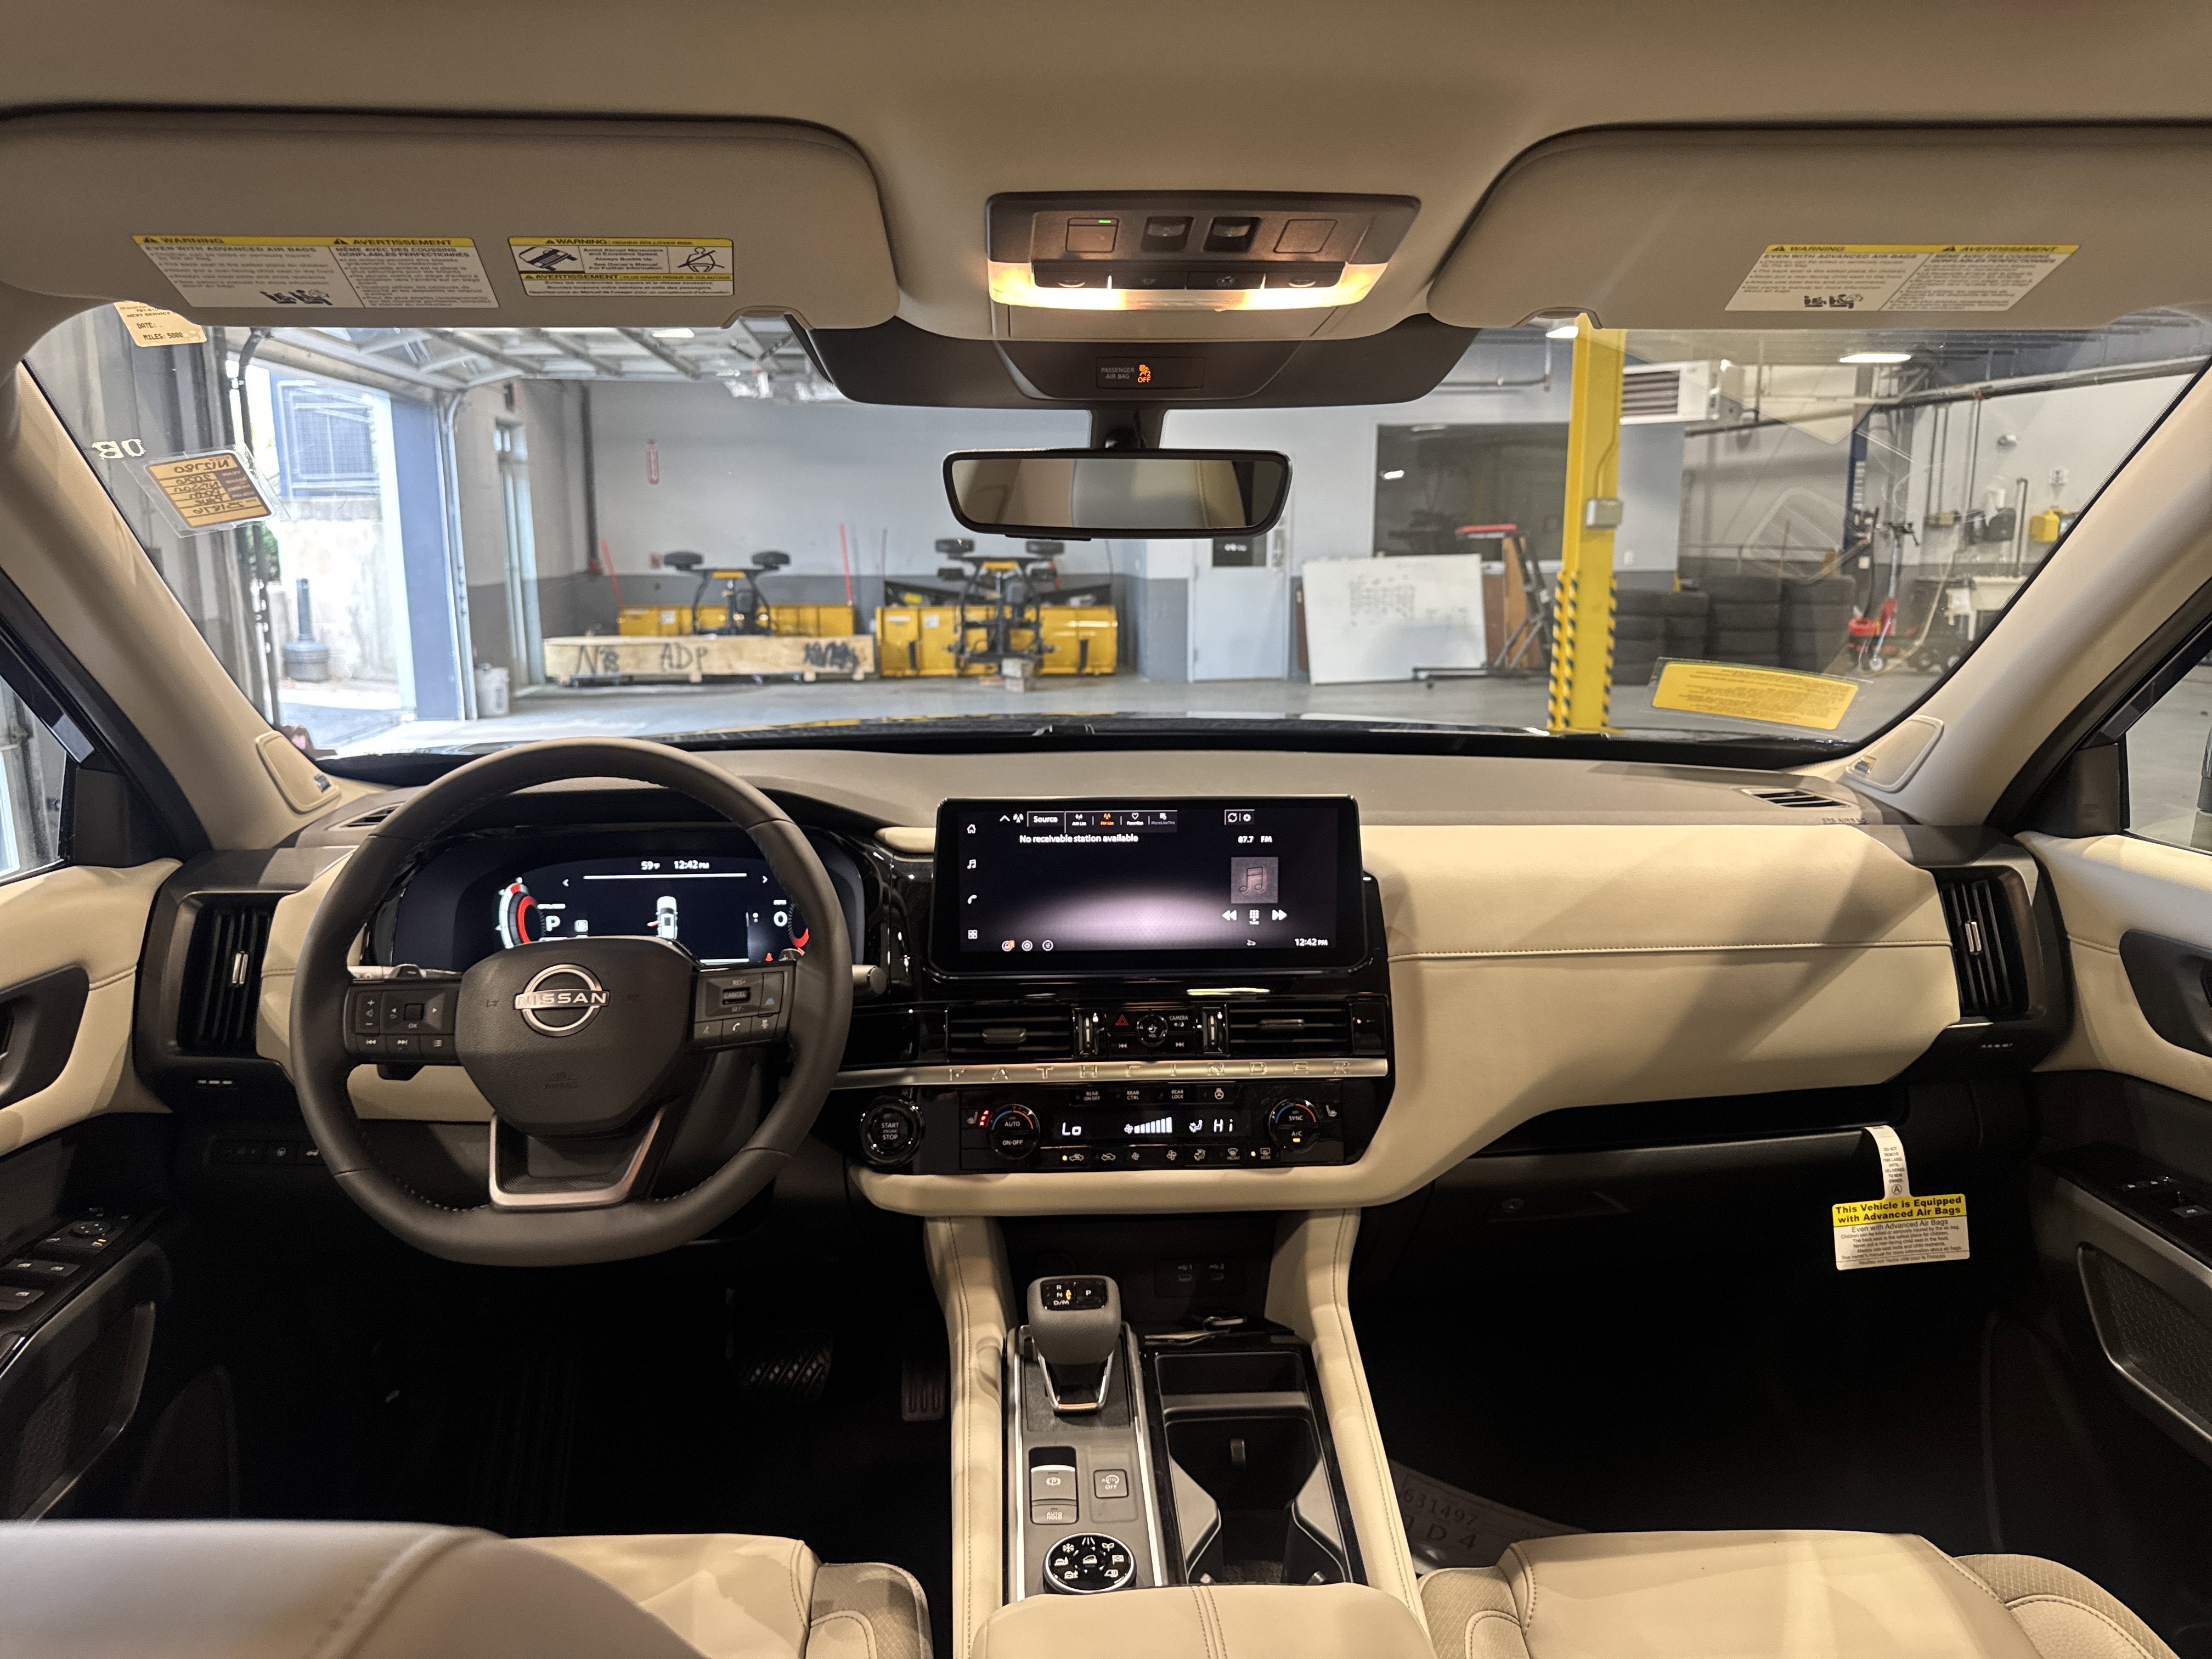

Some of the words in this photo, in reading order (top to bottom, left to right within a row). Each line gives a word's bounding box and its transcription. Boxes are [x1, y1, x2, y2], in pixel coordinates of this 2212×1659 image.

[1019, 834, 1031, 843] No
[1032, 834, 1073, 843] receivable
[1074, 834, 1101, 843] station
[1102, 833, 1138, 842] available
[1260, 835, 1273, 843] FM
[545, 915, 560, 932] P
[517, 992, 606, 1007] NISSAN
[949, 1060, 1351, 1081] PATHFINDER
[1062, 1122, 1082, 1136] Lo
[1213, 1118, 1234, 1132] Hi
[1835, 1206, 1858, 1214] This
[1860, 1201, 1898, 1211] Vehicle
[1914, 1196, 1962, 1208] Equipped
[1837, 1215, 1860, 1223] with
[1863, 1209, 1914, 1221] Advanced
[1934, 1207, 1961, 1216] Bags
[1884, 1221, 1918, 1229] Advanced
